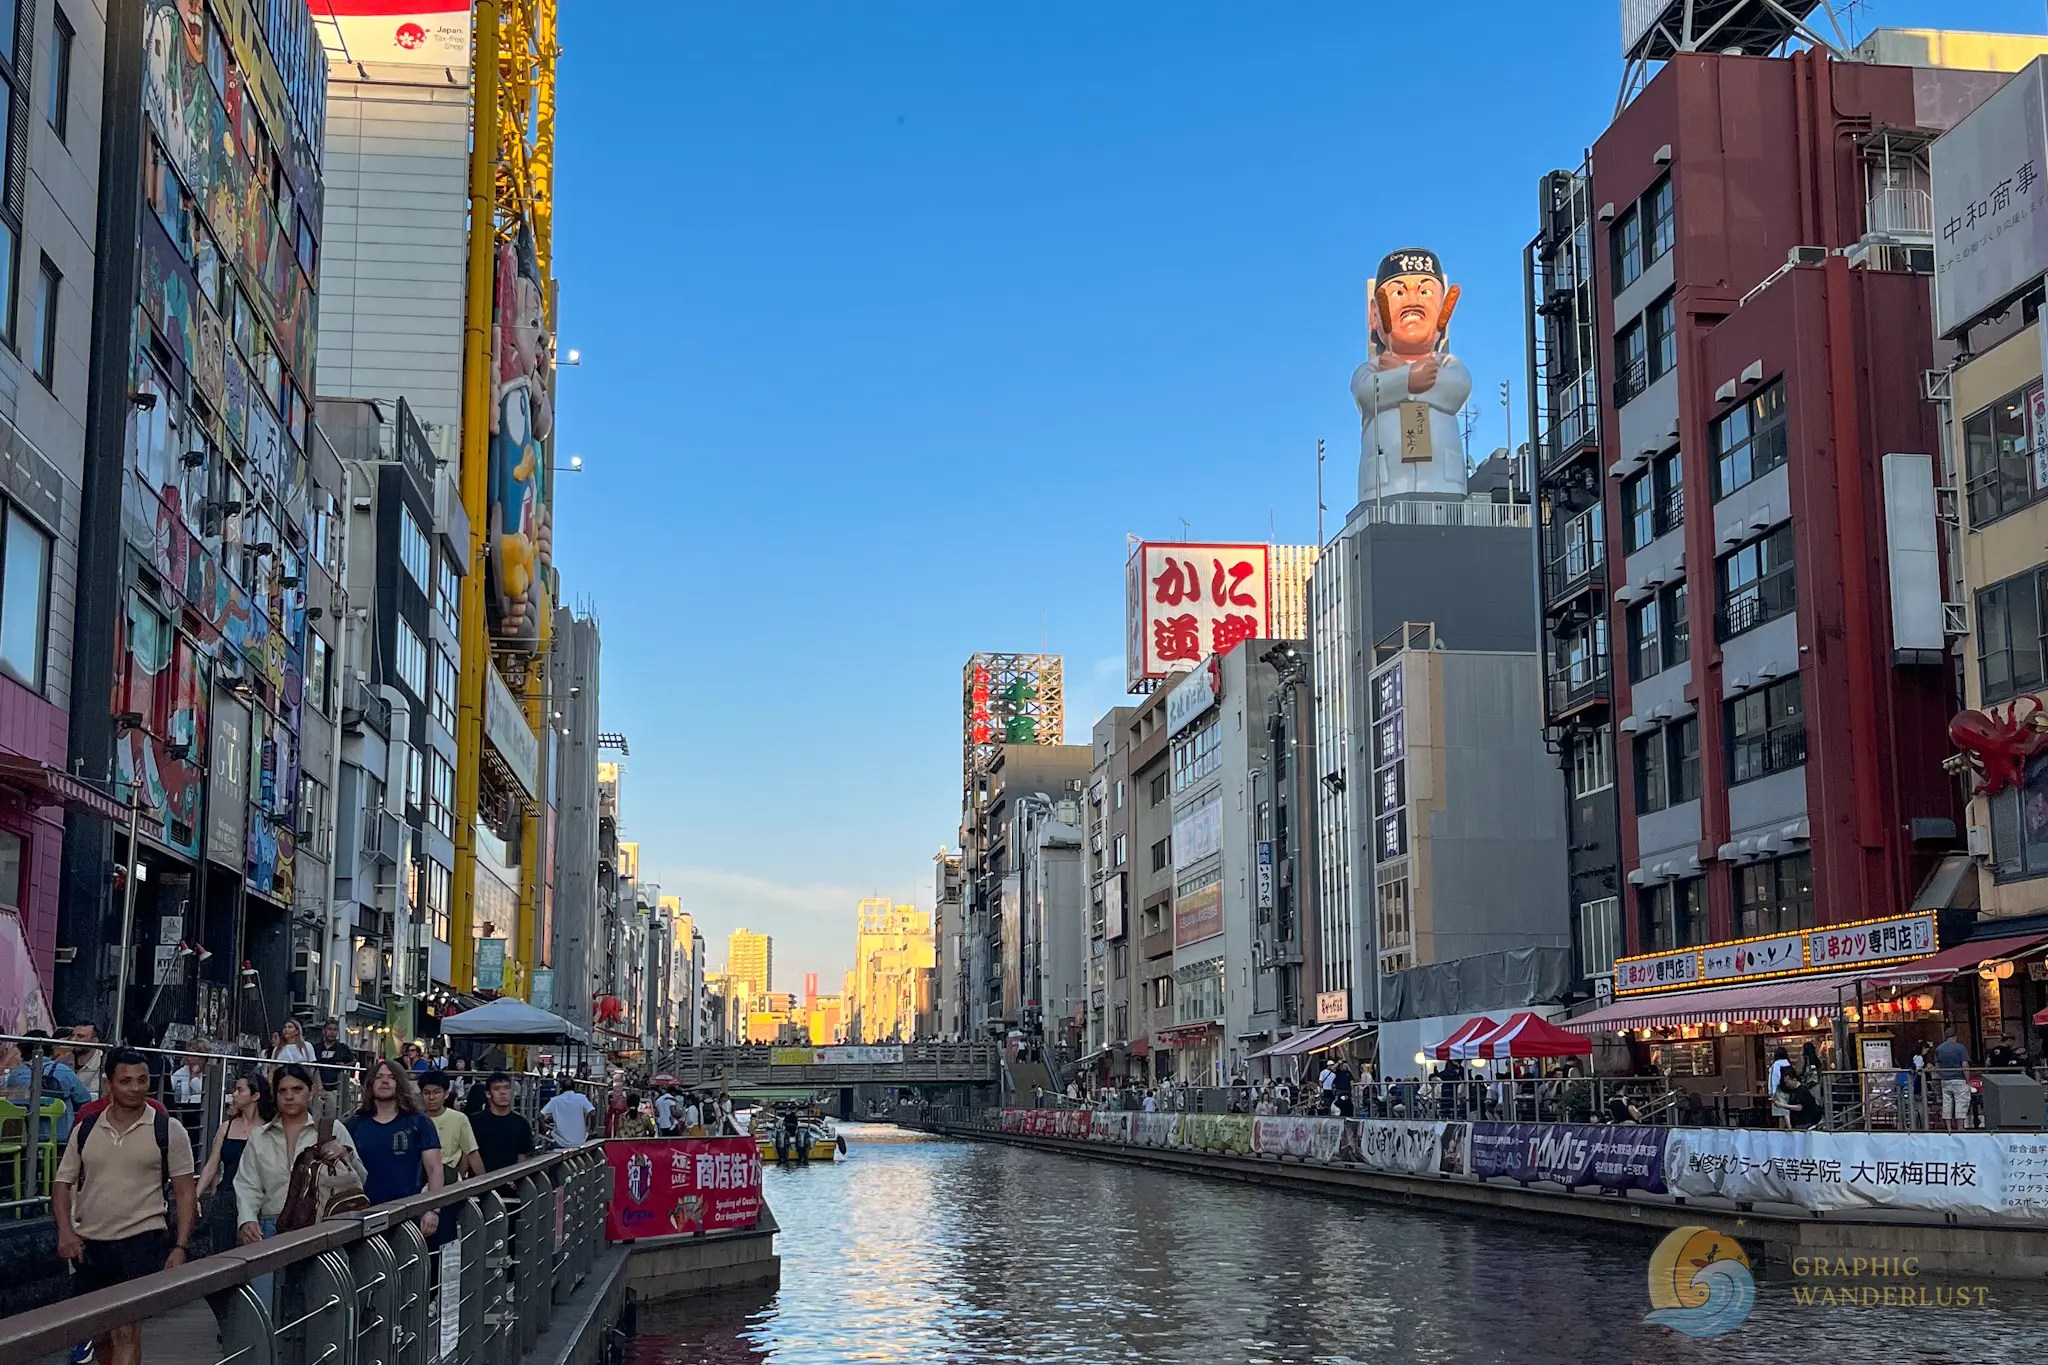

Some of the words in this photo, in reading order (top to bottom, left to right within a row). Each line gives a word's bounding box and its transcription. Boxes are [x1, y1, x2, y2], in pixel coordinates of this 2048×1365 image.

[434, 34, 464, 43] Tax-free
[437, 26, 463, 34] Japan.
[444, 43, 464, 51] Shop
[1943, 160, 2038, 245] 中和商事
[1399, 255, 1435, 273] だるま
[1152, 557, 1257, 607] かに
[1260, 866, 1270, 906] いろりや
[1828, 925, 1911, 959] 串カツ専門店
[1629, 958, 1684, 984] 串カツ専門店
[1850, 1160, 1976, 1187] 大阪梅田校
[715, 1212, 725, 1222] Our
